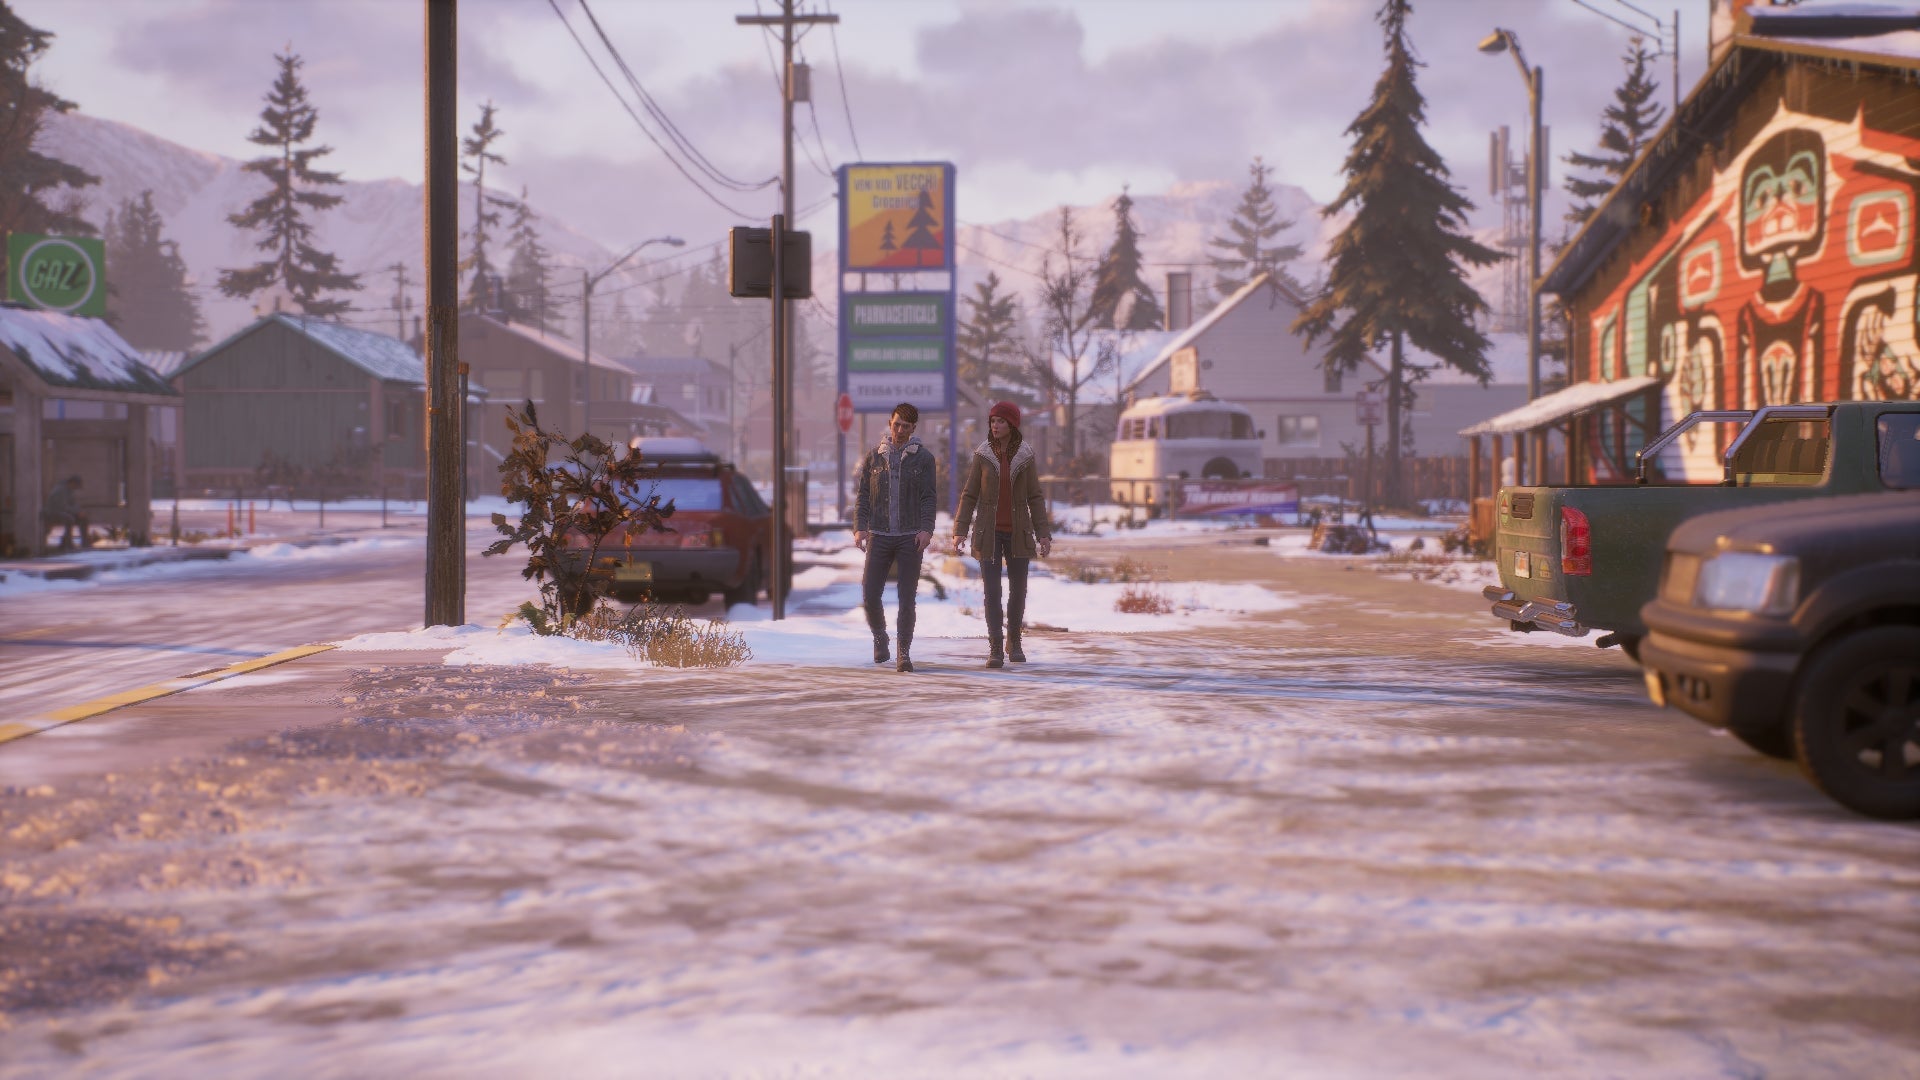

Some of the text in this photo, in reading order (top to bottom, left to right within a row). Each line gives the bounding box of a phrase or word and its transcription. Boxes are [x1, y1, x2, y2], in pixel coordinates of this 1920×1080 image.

[896, 173, 938, 191] VECCHI
[31, 259, 78, 290] GAZ
[855, 304, 937, 325] PHARMACEUTICALS
[857, 385, 902, 396] TESSA'S
